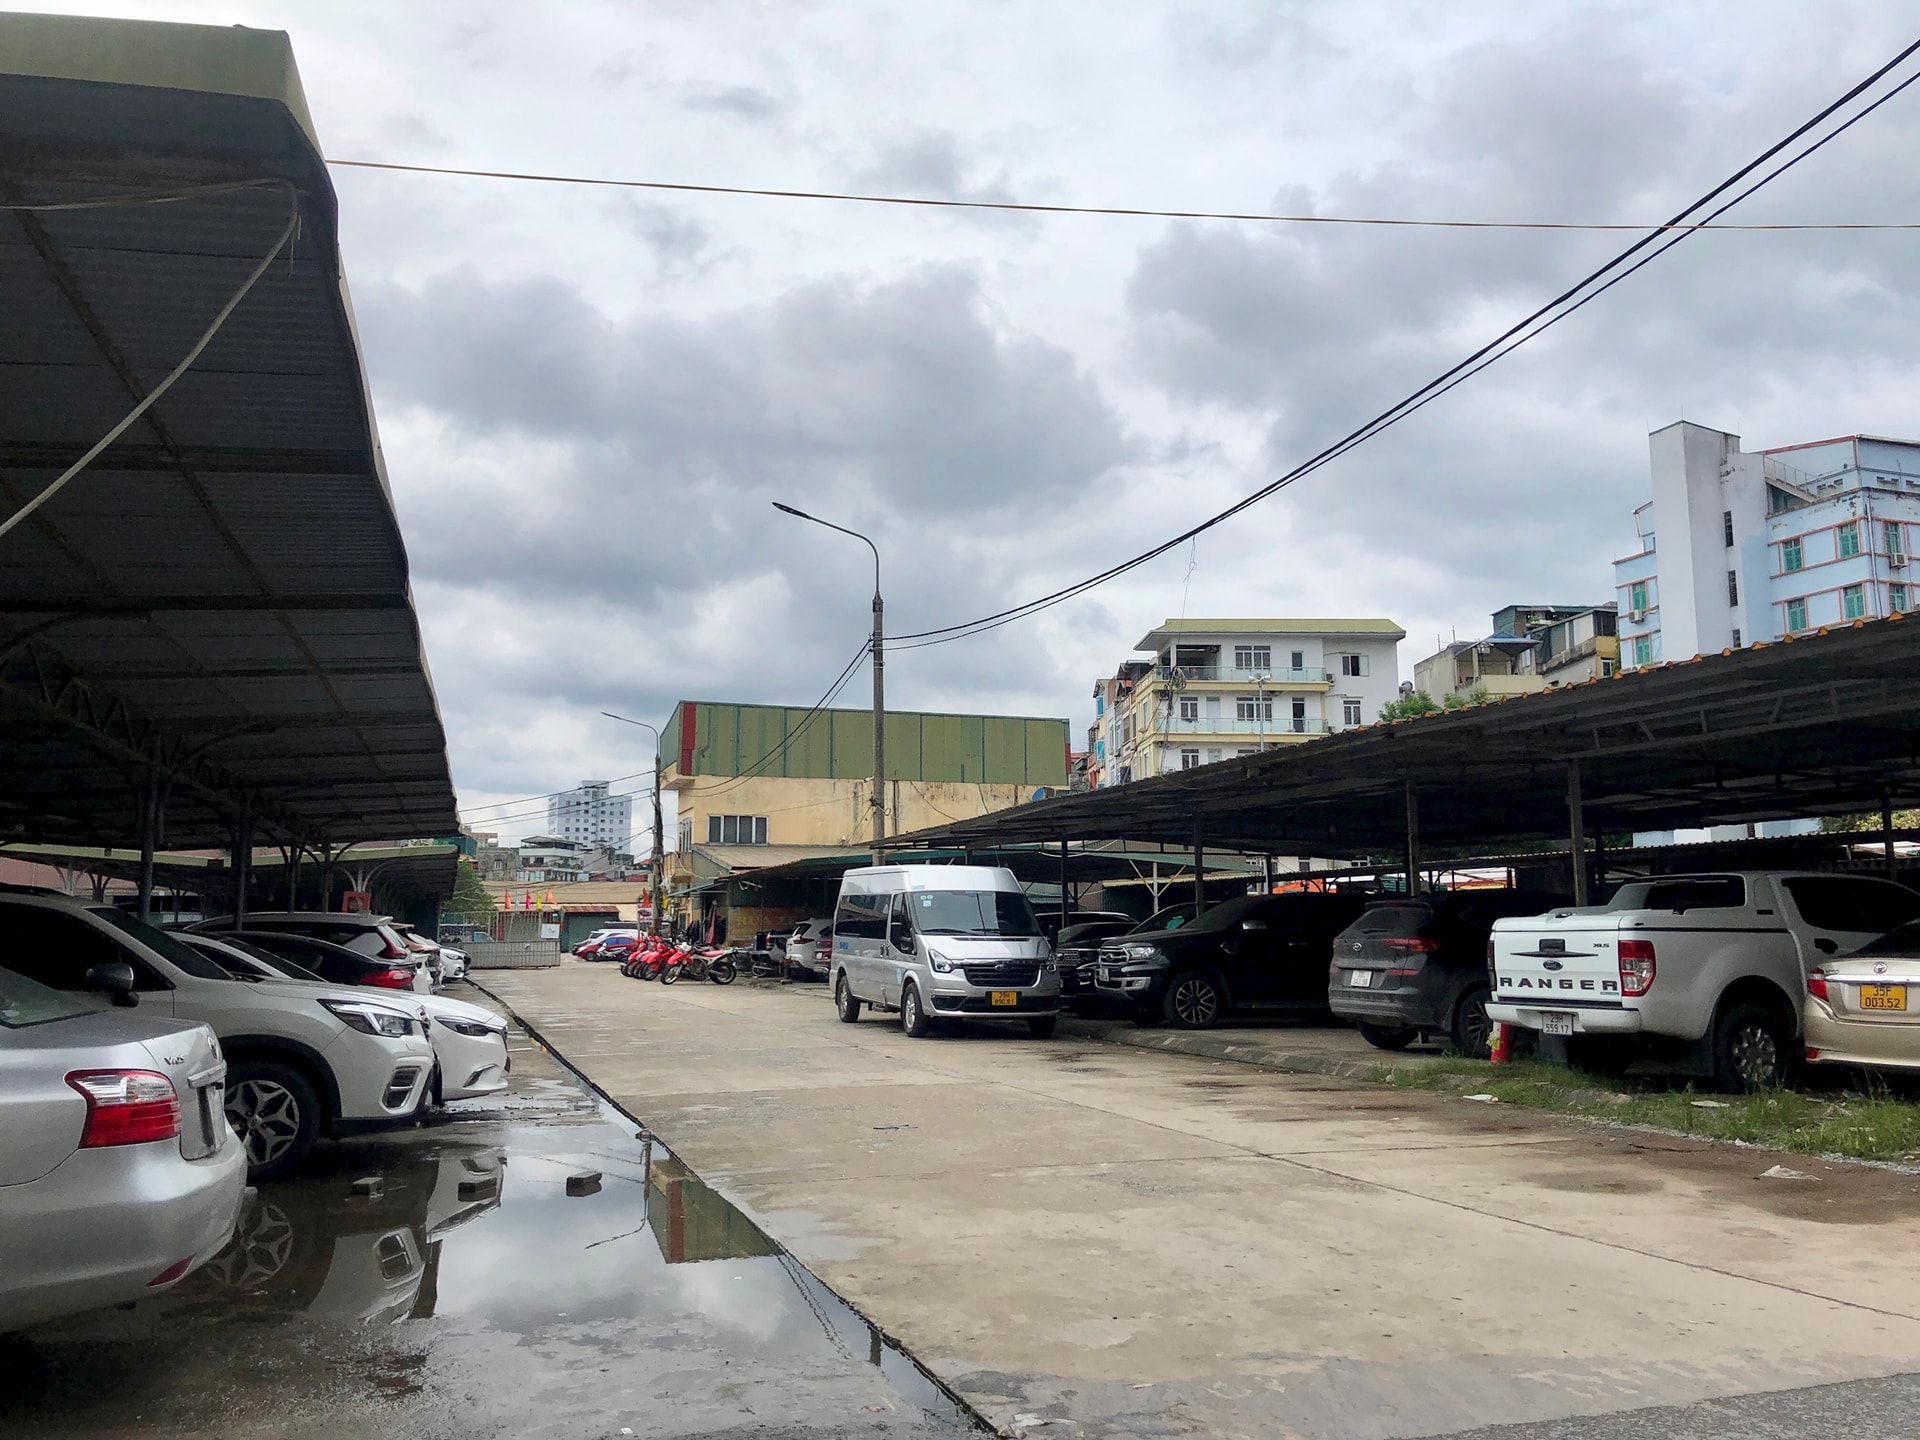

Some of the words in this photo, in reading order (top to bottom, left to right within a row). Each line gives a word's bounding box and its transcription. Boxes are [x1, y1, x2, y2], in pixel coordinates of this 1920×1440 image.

[1500, 977, 1618, 991] RANGER
[1873, 985, 1892, 997] 35F
[1865, 997, 1901, 1008] 003.52
[1550, 1014, 1564, 1023] 29H
[1545, 1024, 1569, 1034] 559.17
